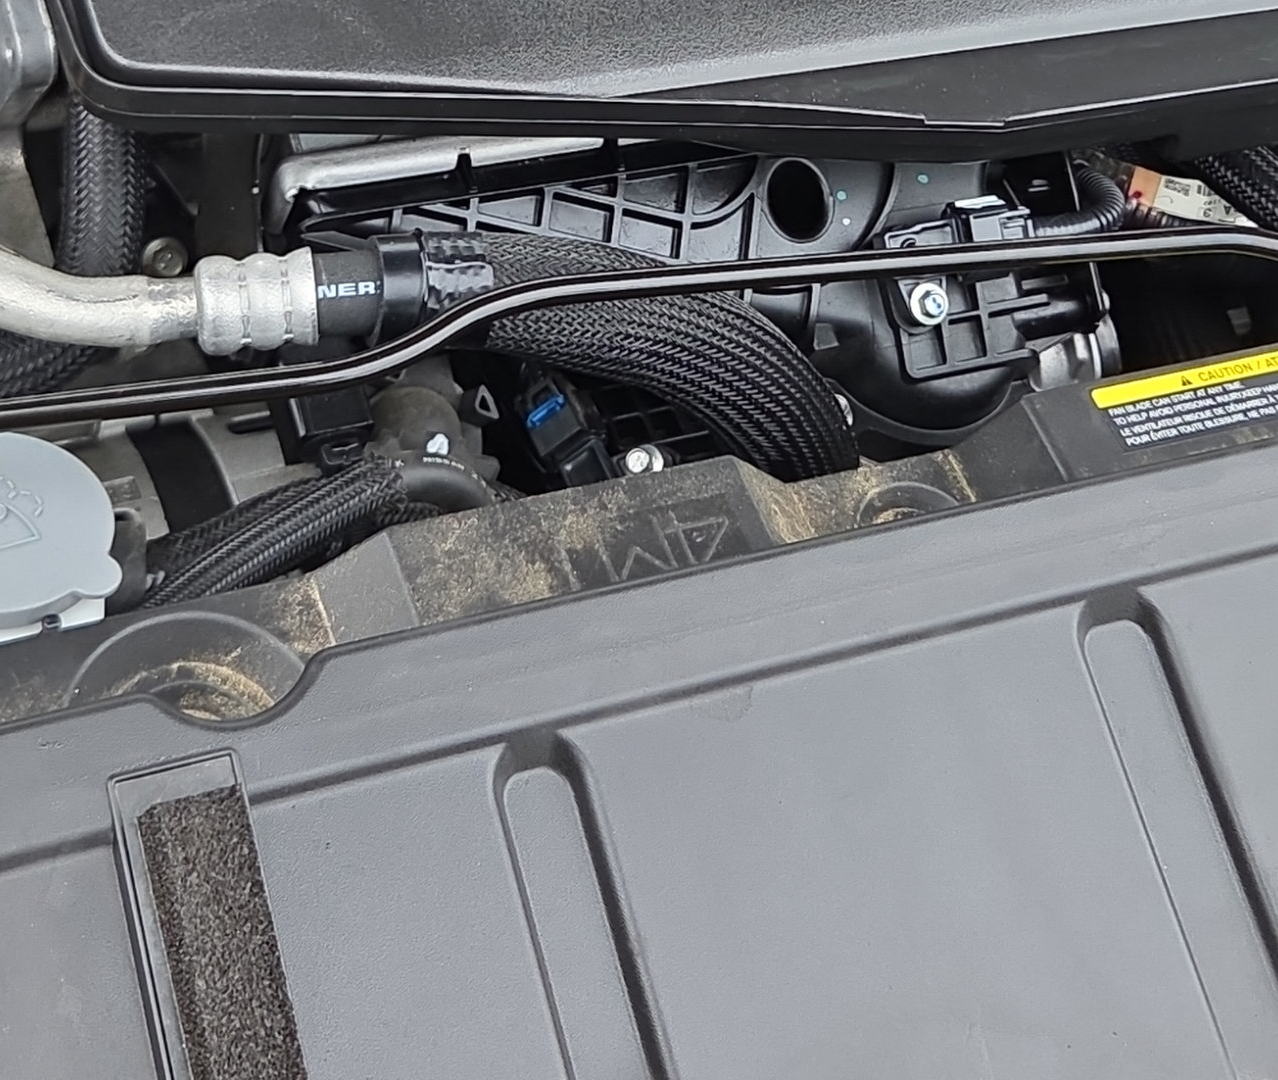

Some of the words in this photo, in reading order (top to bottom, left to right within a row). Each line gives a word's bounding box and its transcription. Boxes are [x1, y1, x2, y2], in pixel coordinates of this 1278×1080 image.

[1198, 362, 1254, 382] CAUTION
[1107, 406, 1126, 417] FAN
[1125, 402, 1153, 414] BLADE
[1152, 396, 1171, 407] CAN
[1171, 391, 1196, 404] START
[1196, 388, 1207, 397] AT
[1206, 384, 1224, 395] ANY
[1113, 417, 1127, 426] TO
[1127, 412, 1148, 424] HELP
[1149, 407, 1173, 419] AVOID
[1173, 398, 1217, 415] PERSONAL
[1120, 427, 1131, 437] LE
[1131, 416, 1183, 435] VENTILATEUR
[1214, 406, 1226, 416] DE
[1125, 434, 1151, 447] POUR
[1178, 423, 1205, 435] TOUTE
[1248, 408, 1260, 419] NE
[1259, 404, 1276, 417] PAS
